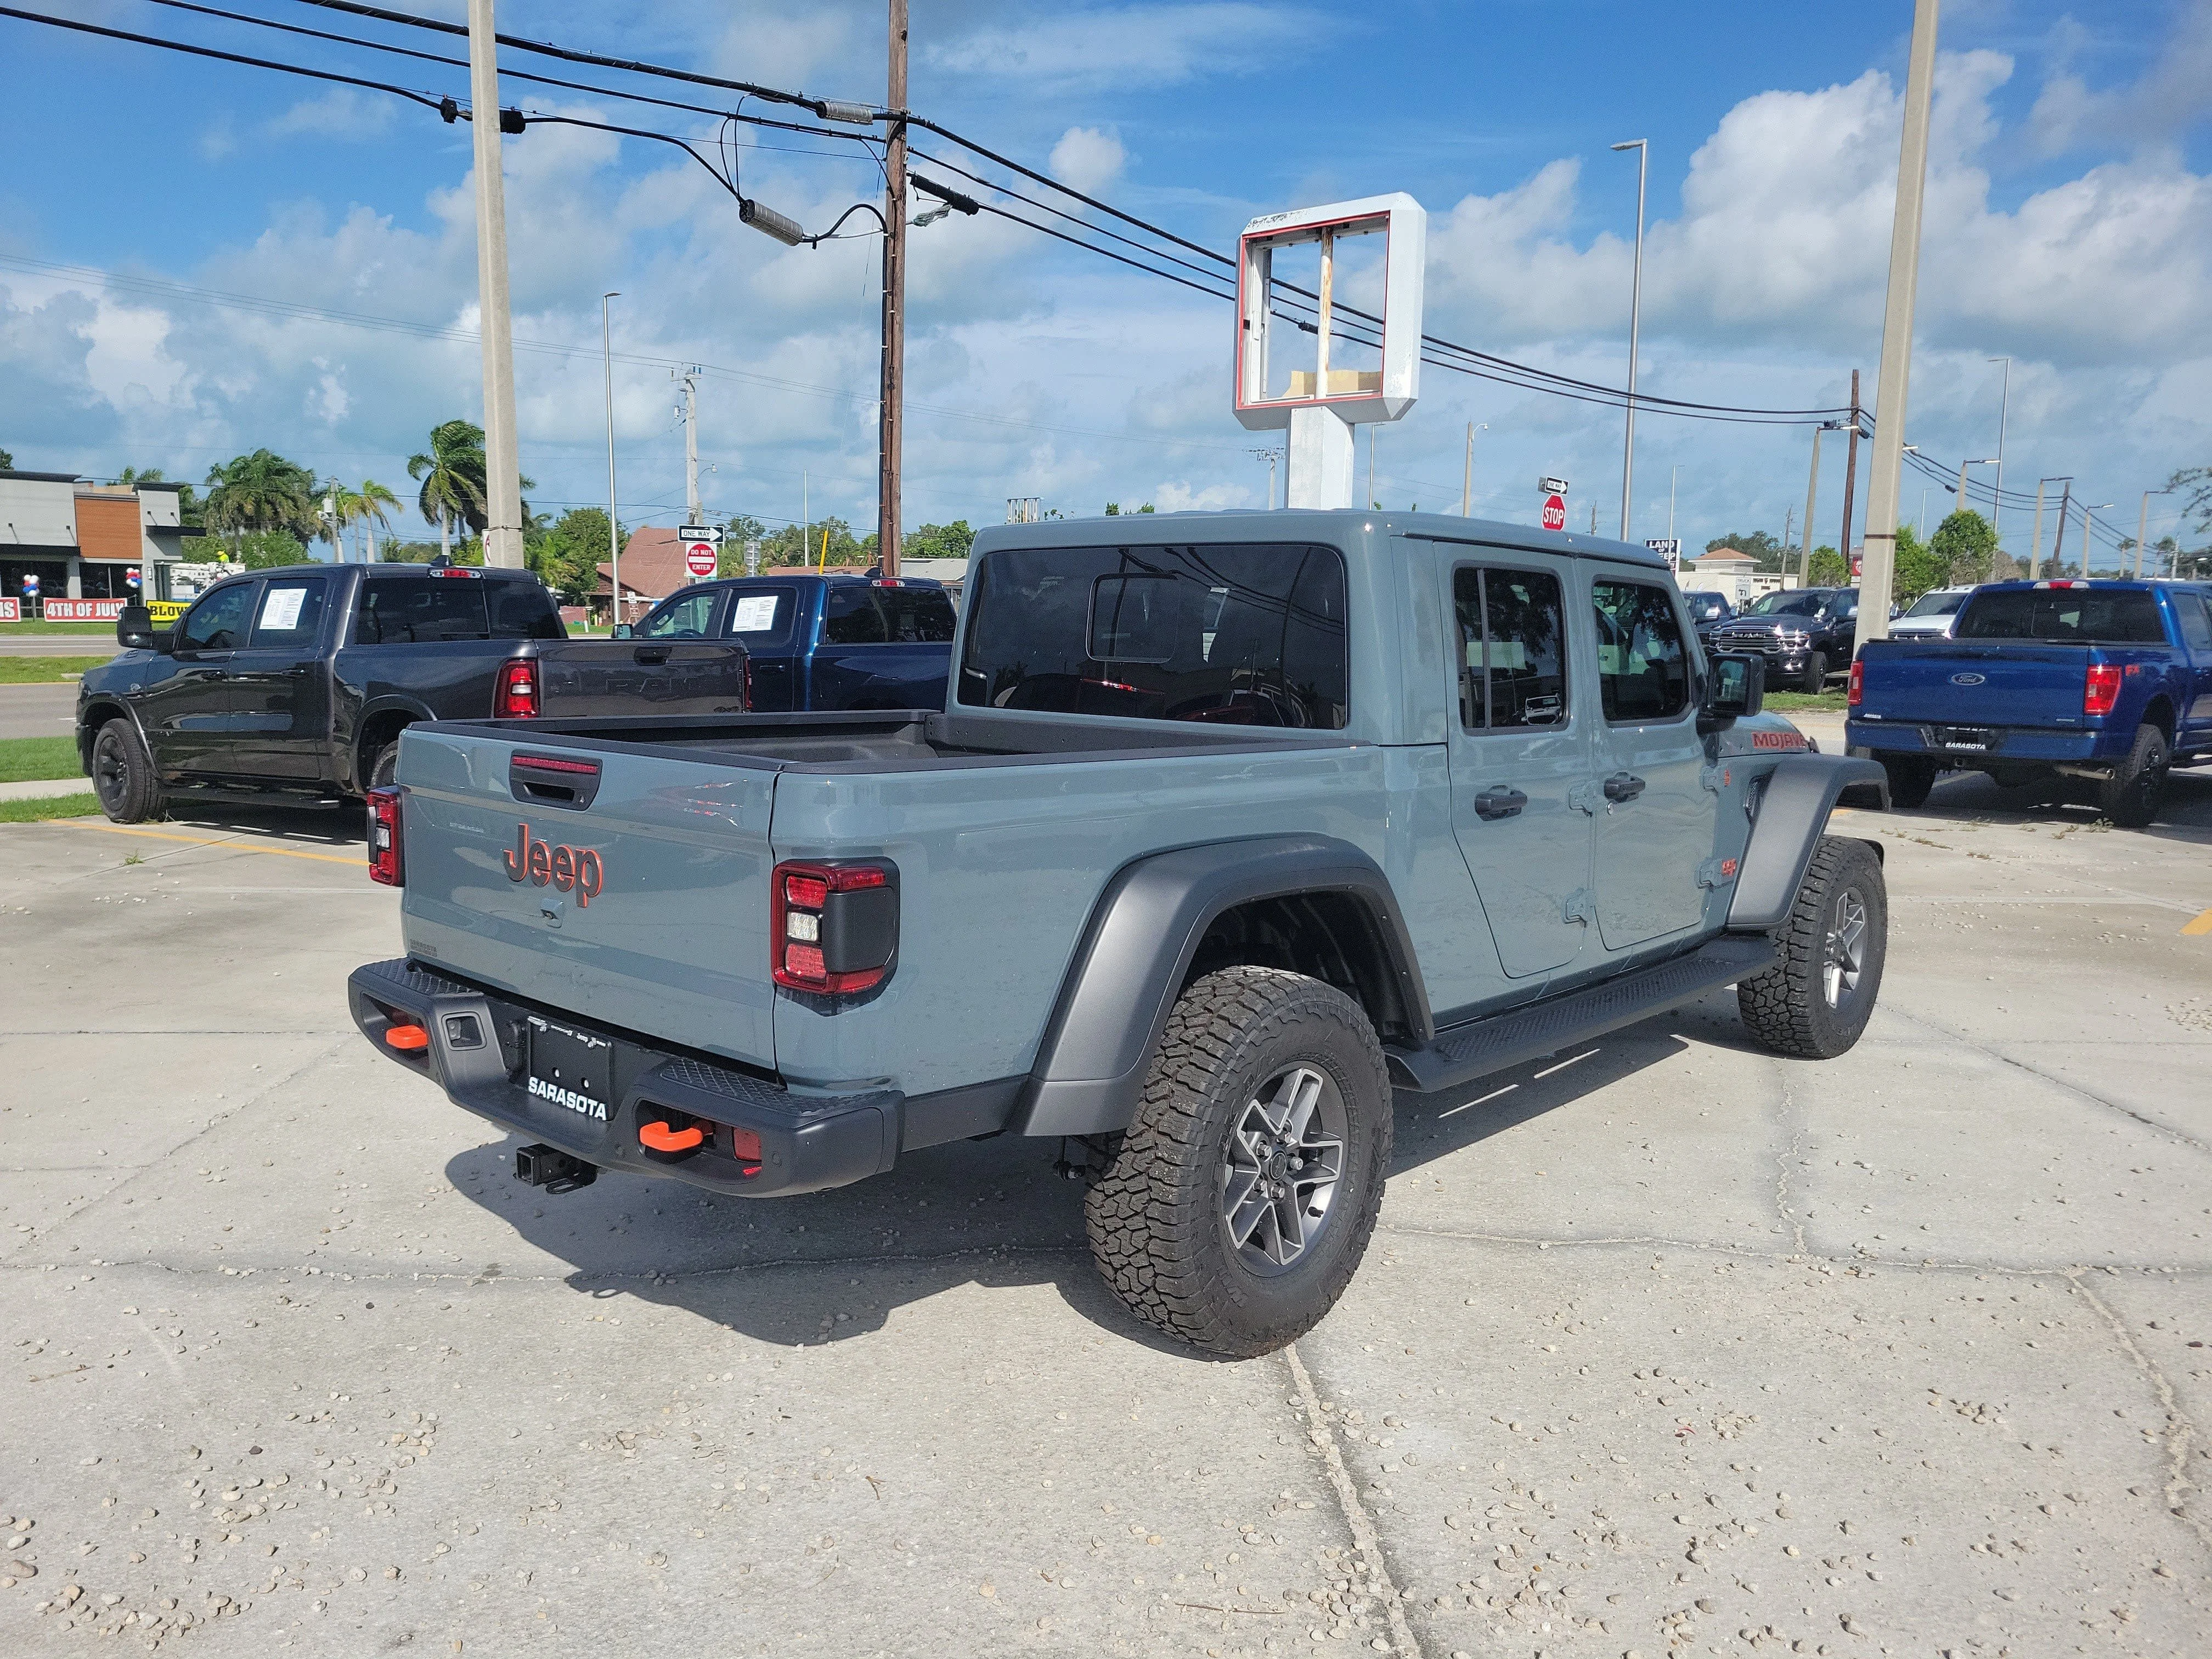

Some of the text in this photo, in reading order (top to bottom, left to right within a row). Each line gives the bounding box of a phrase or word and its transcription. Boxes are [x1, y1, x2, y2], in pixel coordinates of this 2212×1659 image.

[1543, 506, 1564, 525] STOP
[47, 602, 72, 617] 4TH
[76, 602, 93, 617] OF
[504, 823, 603, 908] Jeep
[528, 1076, 607, 1121] SARASOTA
